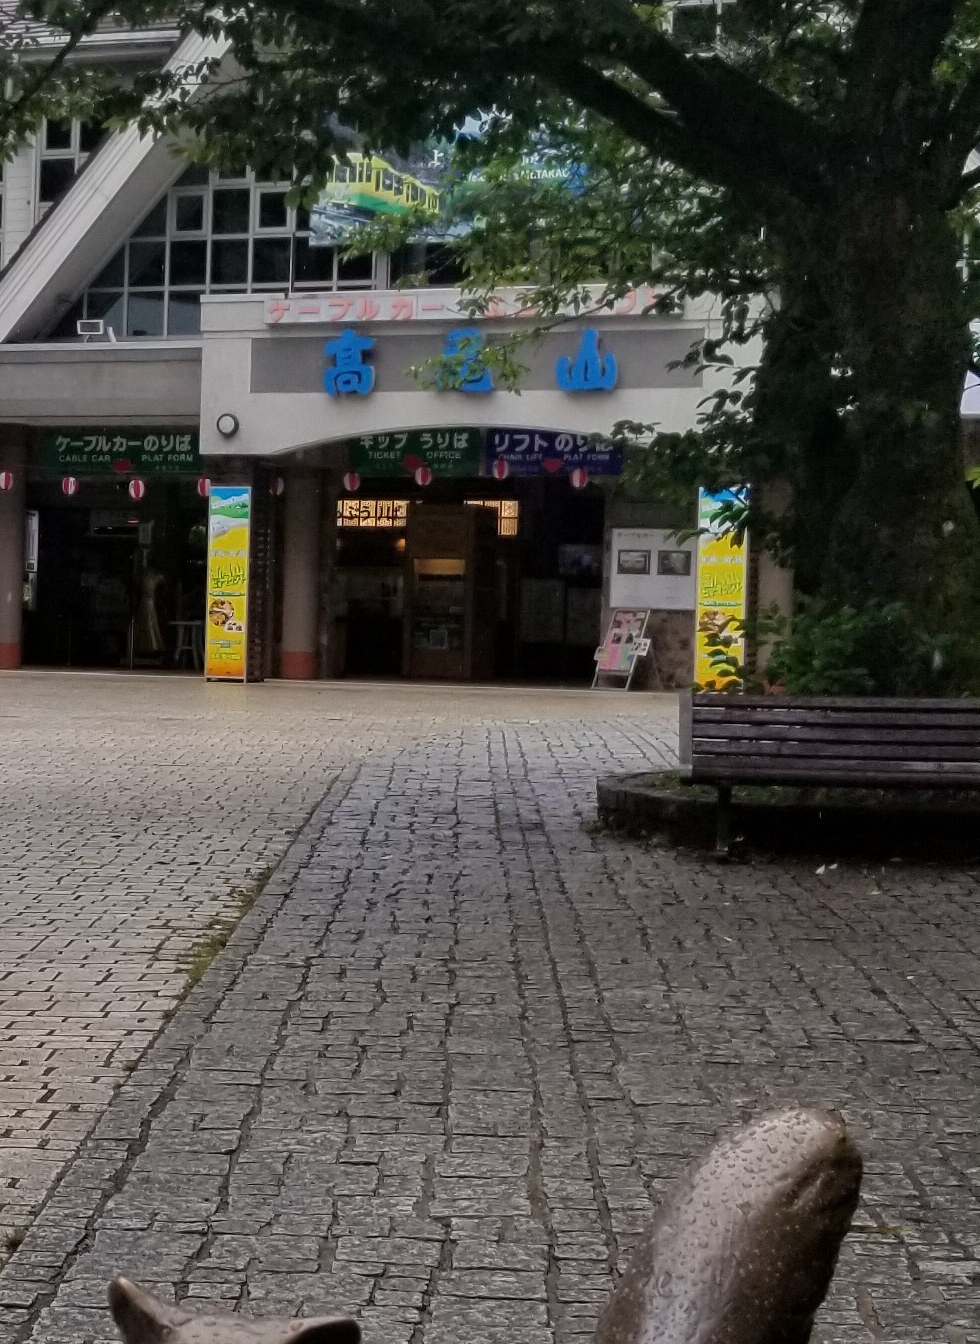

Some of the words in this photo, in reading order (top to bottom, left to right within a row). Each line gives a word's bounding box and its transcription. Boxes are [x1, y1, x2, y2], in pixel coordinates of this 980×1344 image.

[55, 434, 192, 452] ケーブルカーのりば
[420, 432, 469, 449] うりば
[494, 433, 548, 452] リフト
[59, 454, 87, 462] CABLE
[91, 454, 111, 462] CAR
[141, 454, 164, 462] PLAT
[167, 454, 193, 462] FORM
[368, 451, 401, 459] TICKET
[426, 451, 460, 459] OFFICE
